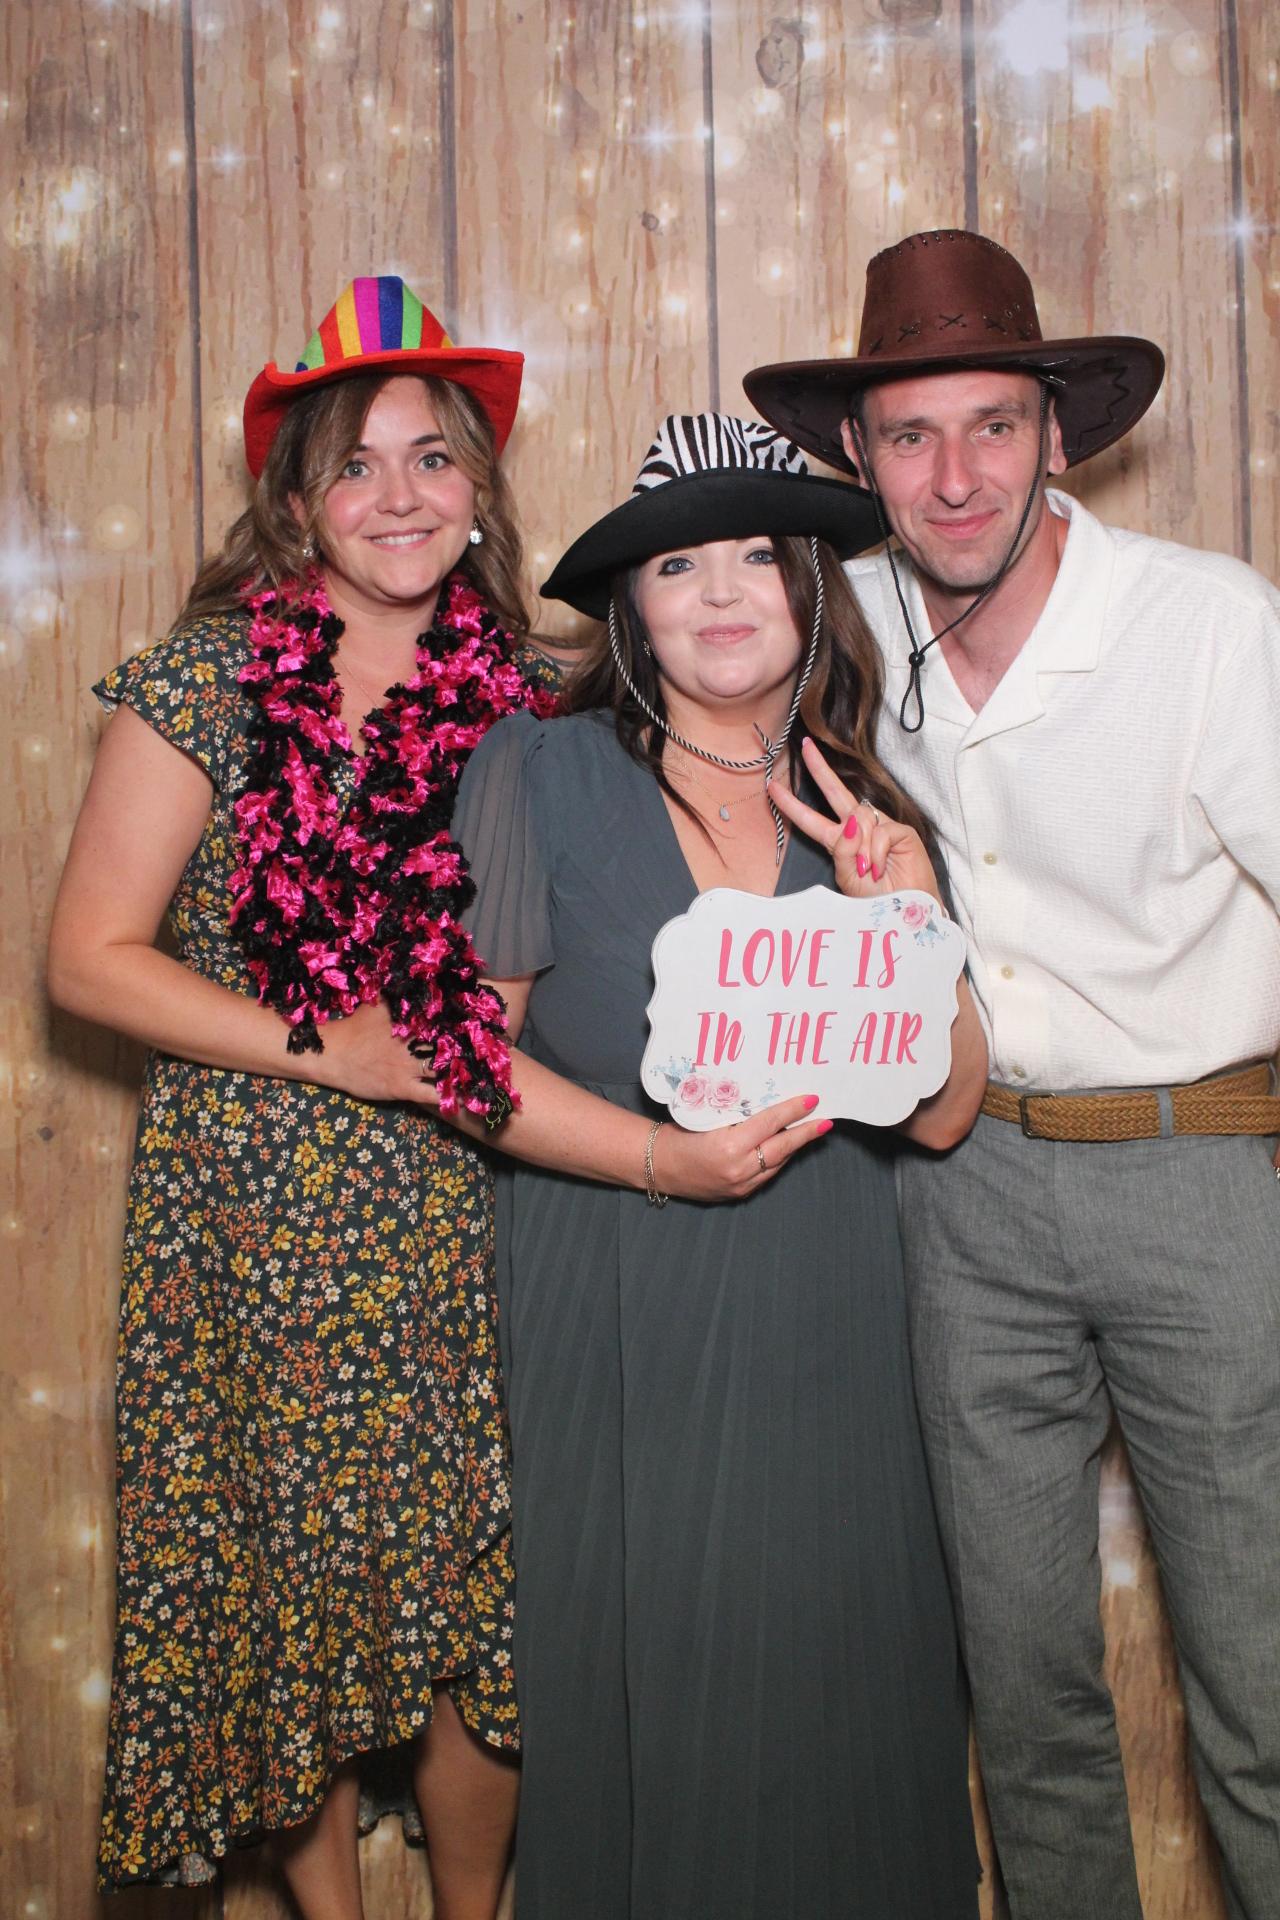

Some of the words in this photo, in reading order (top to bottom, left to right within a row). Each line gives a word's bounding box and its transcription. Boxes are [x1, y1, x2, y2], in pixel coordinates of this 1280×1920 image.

[717, 928, 836, 988] LOVE
[852, 929, 902, 989] IS
[766, 1012, 838, 1066] THE
[849, 1012, 924, 1065] AIR
